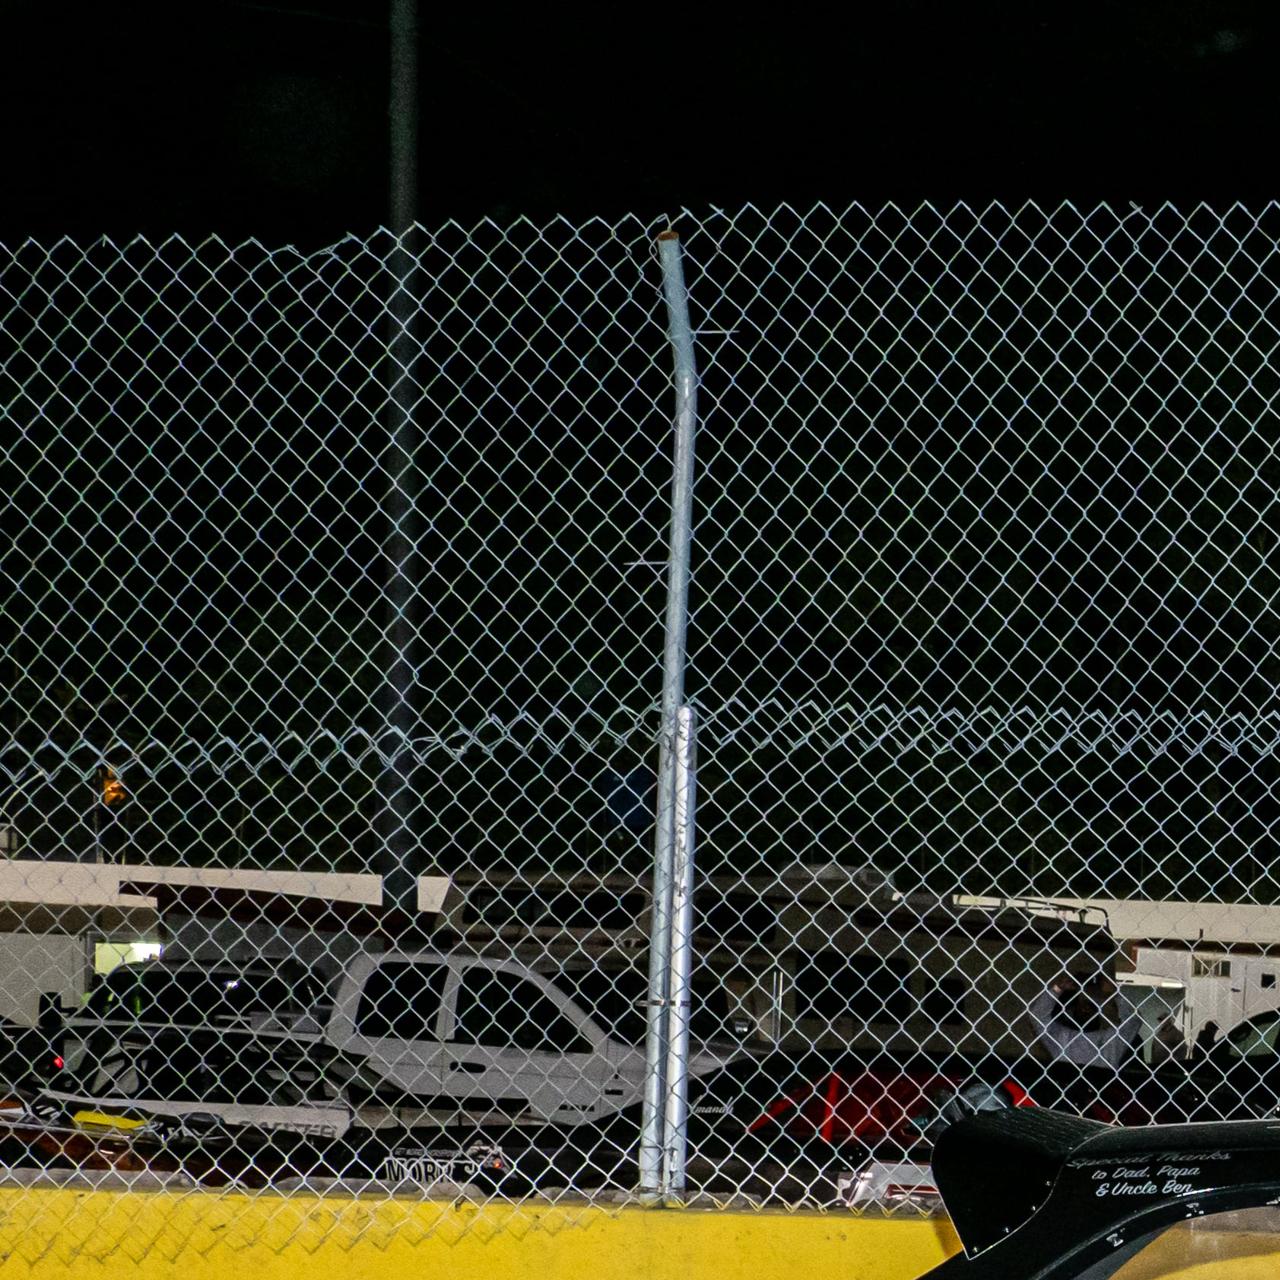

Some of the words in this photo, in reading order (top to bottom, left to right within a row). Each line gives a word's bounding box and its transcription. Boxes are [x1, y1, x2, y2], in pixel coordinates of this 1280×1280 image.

[1091, 1170, 1107, 1180] to
[1156, 1165, 1200, 1180] Papa
[1095, 1182, 1111, 1197] &
[1111, 1181, 1158, 1196] Uncle
